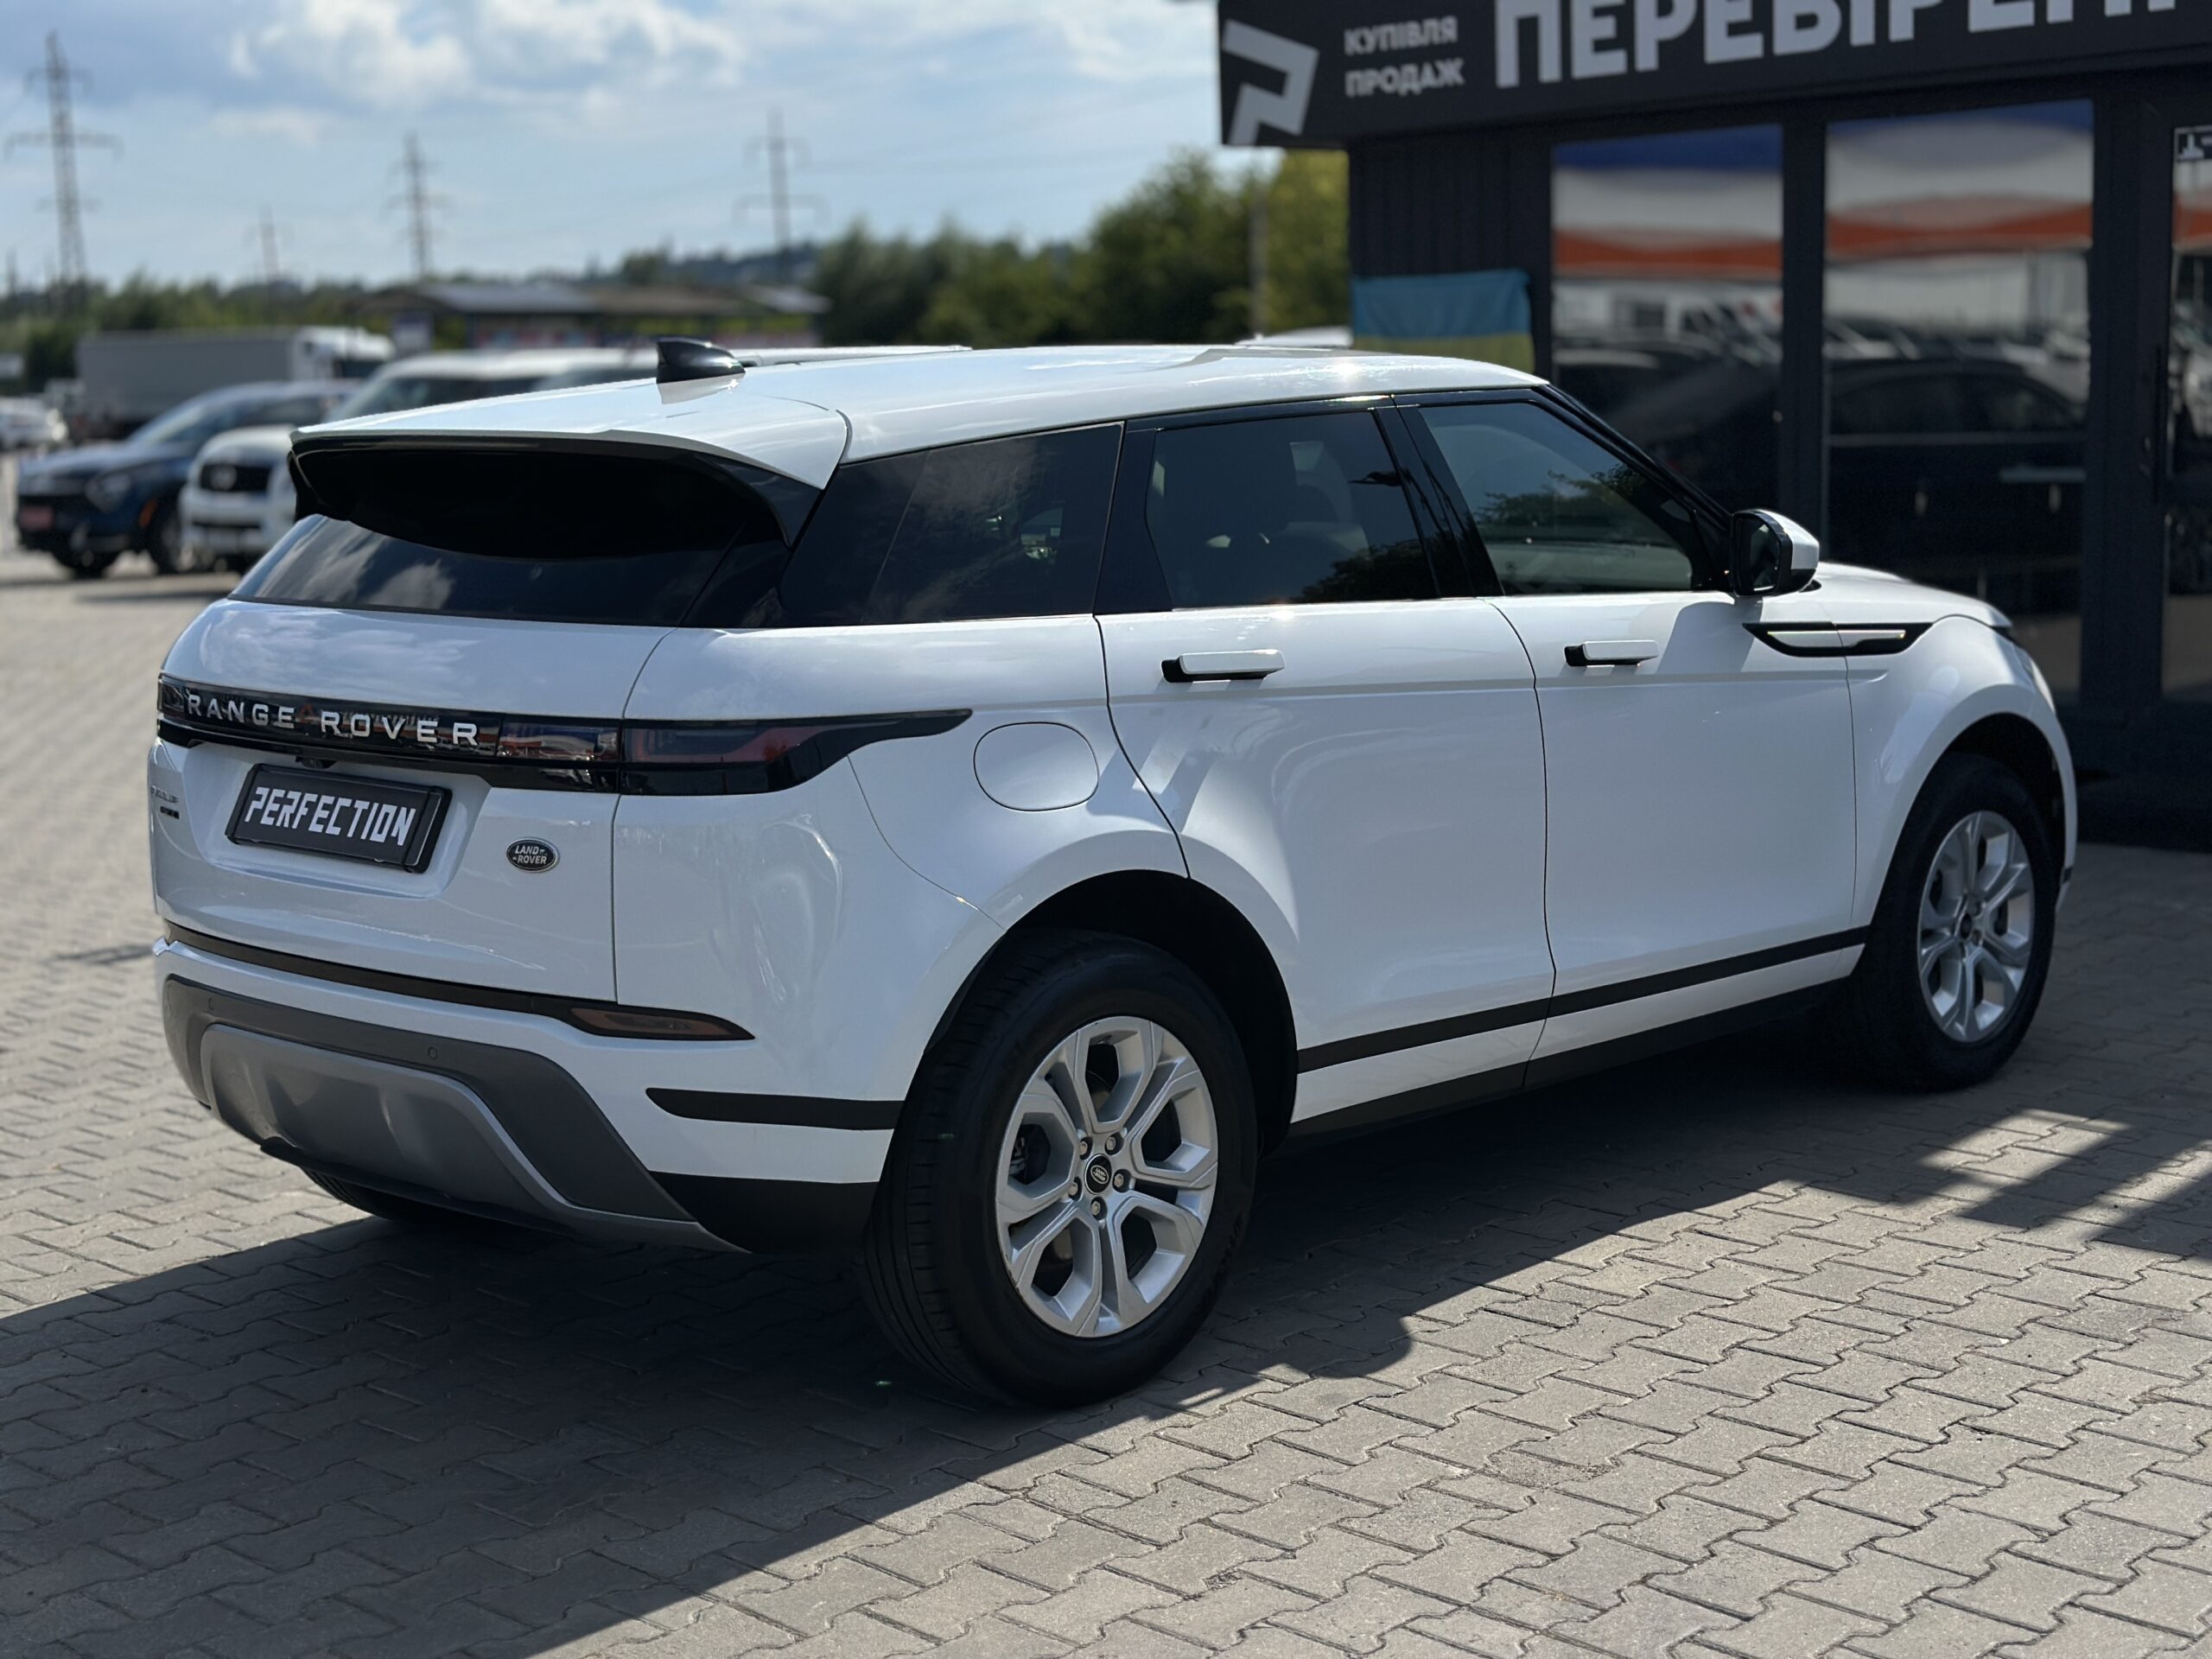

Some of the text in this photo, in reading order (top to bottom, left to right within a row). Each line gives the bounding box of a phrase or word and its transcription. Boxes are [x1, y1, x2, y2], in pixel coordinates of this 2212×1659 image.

[1344, 16, 1458, 55] КУПІВЛЯ
[1345, 60, 1465, 97] ПРОДАЖ
[187, 694, 479, 747] RANGE ROVER
[244, 786, 416, 847] PERFECTION
[514, 845, 540, 855] LAND
[517, 855, 548, 865] ROVER
